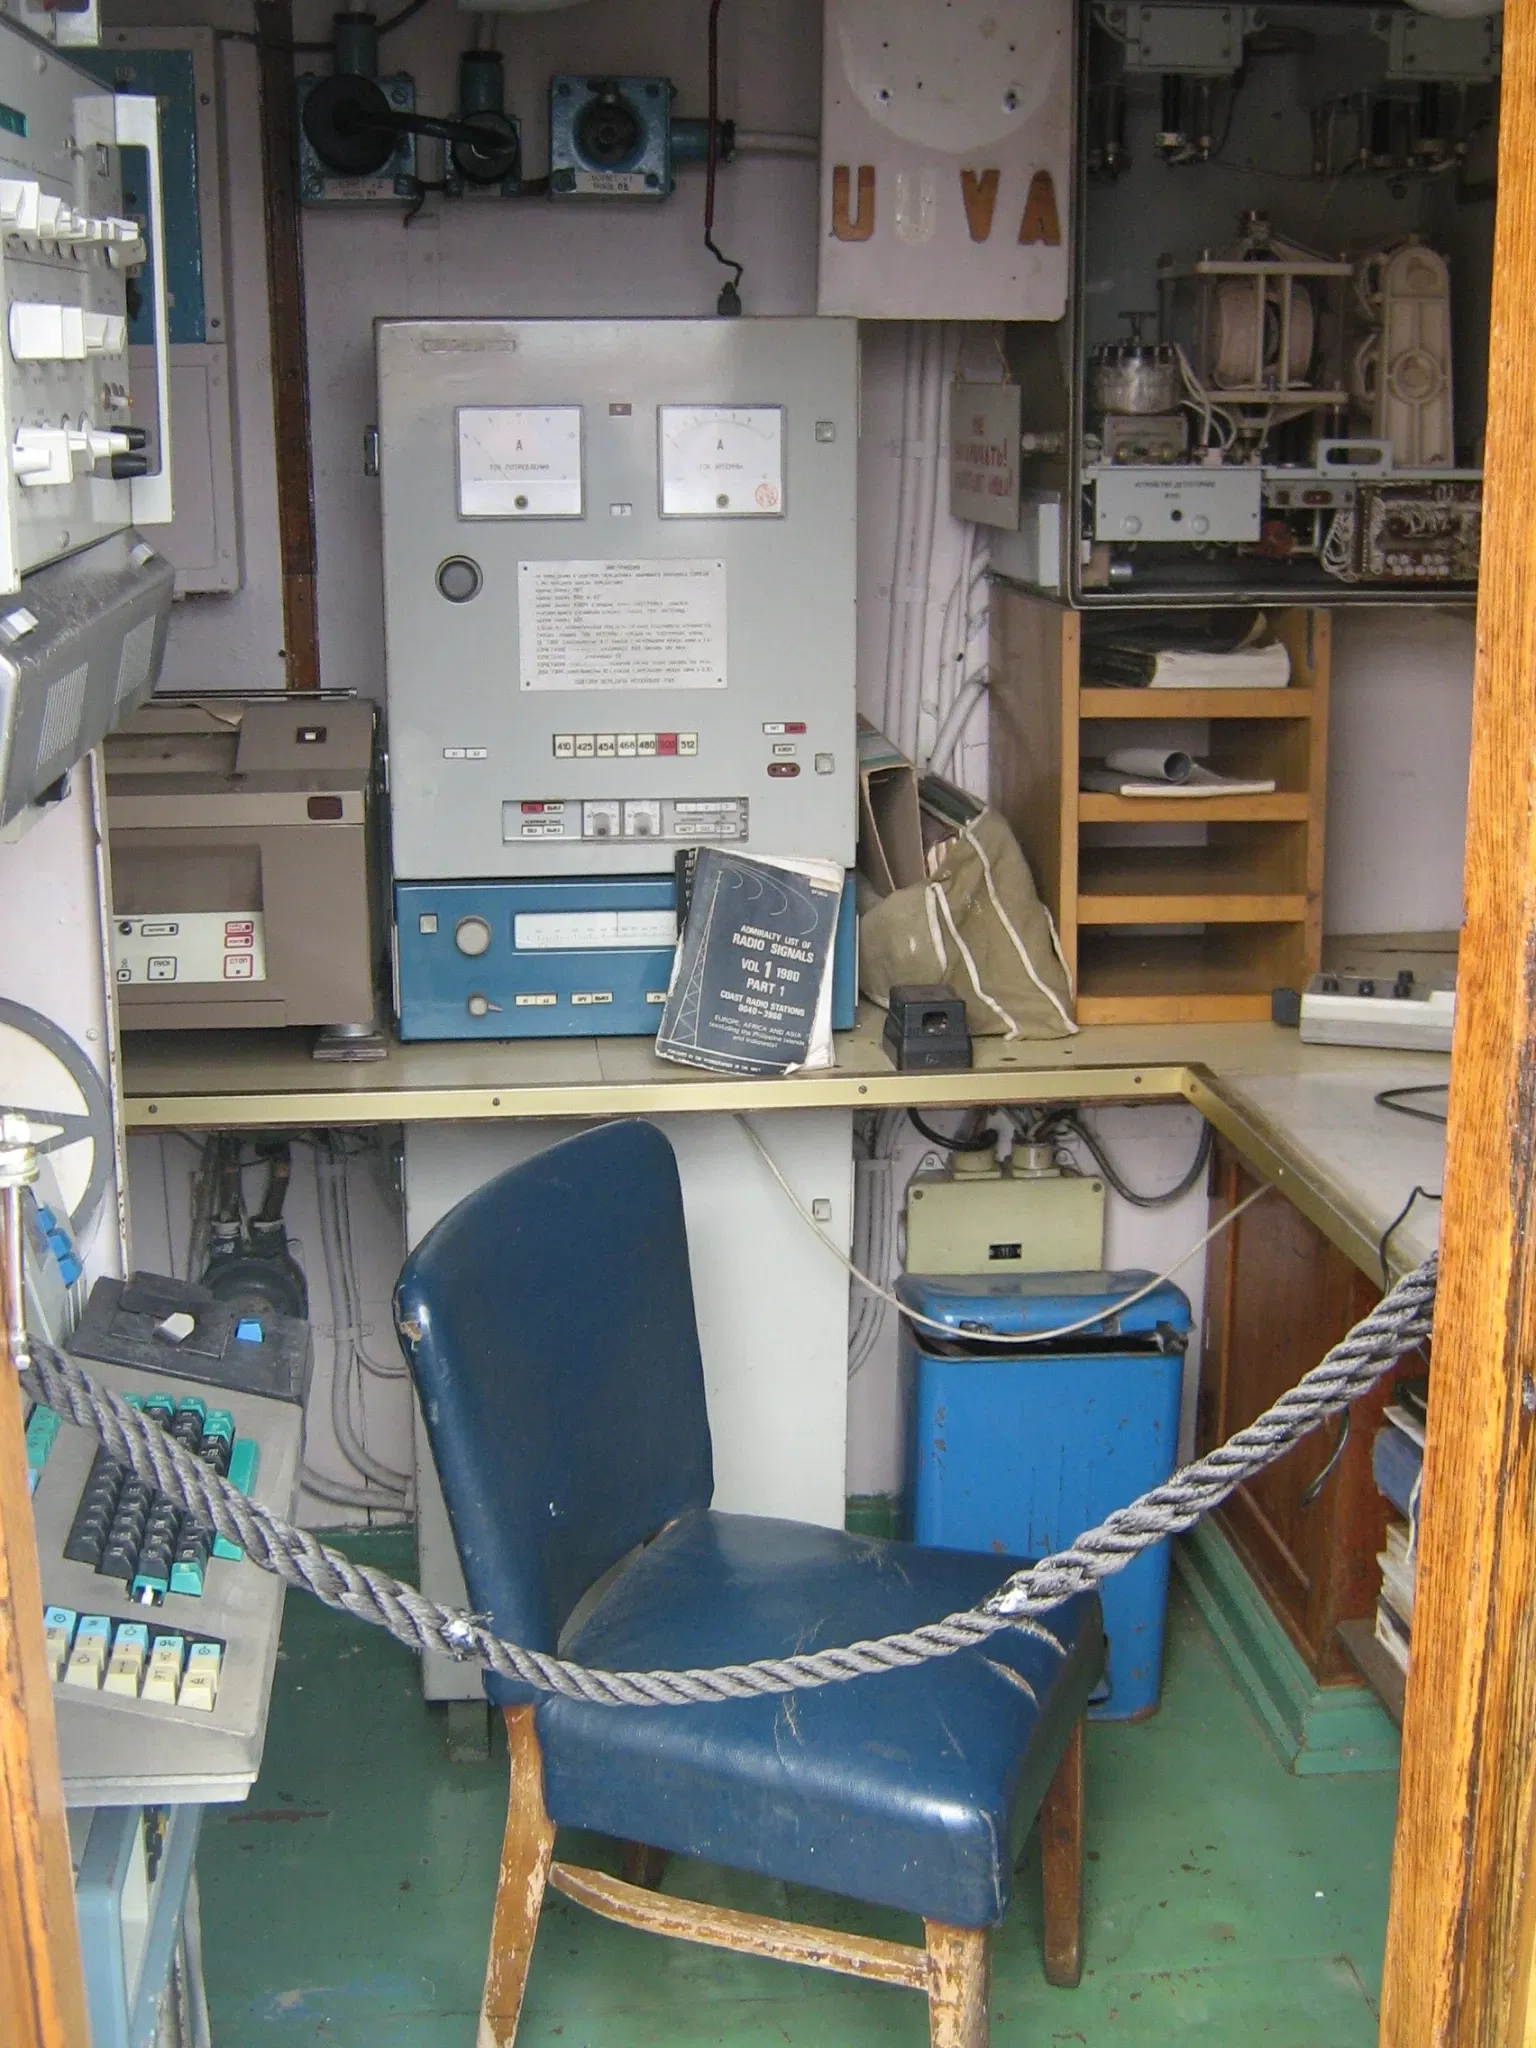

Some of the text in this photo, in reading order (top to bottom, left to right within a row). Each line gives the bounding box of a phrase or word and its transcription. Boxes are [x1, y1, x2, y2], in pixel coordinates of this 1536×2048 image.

[557, 742, 571, 751] 410
[577, 743, 593, 751] 425
[598, 742, 615, 751] 454
[619, 741, 635, 750] 468
[639, 740, 655, 750] 480
[680, 740, 695, 749] 512
[732, 932, 815, 964] RADIO SIGNALS
[740, 924, 812, 949] ADMIRALTY LIST OF
[741, 957, 800, 983] VOL 1 1980
[746, 977, 785, 997] PART 1
[720, 989, 805, 1017] COAST RADIO STATIONS
[743, 1022, 767, 1032] AFRICA
[769, 1027, 784, 1036] AND
[786, 1030, 802, 1038] ASIA
